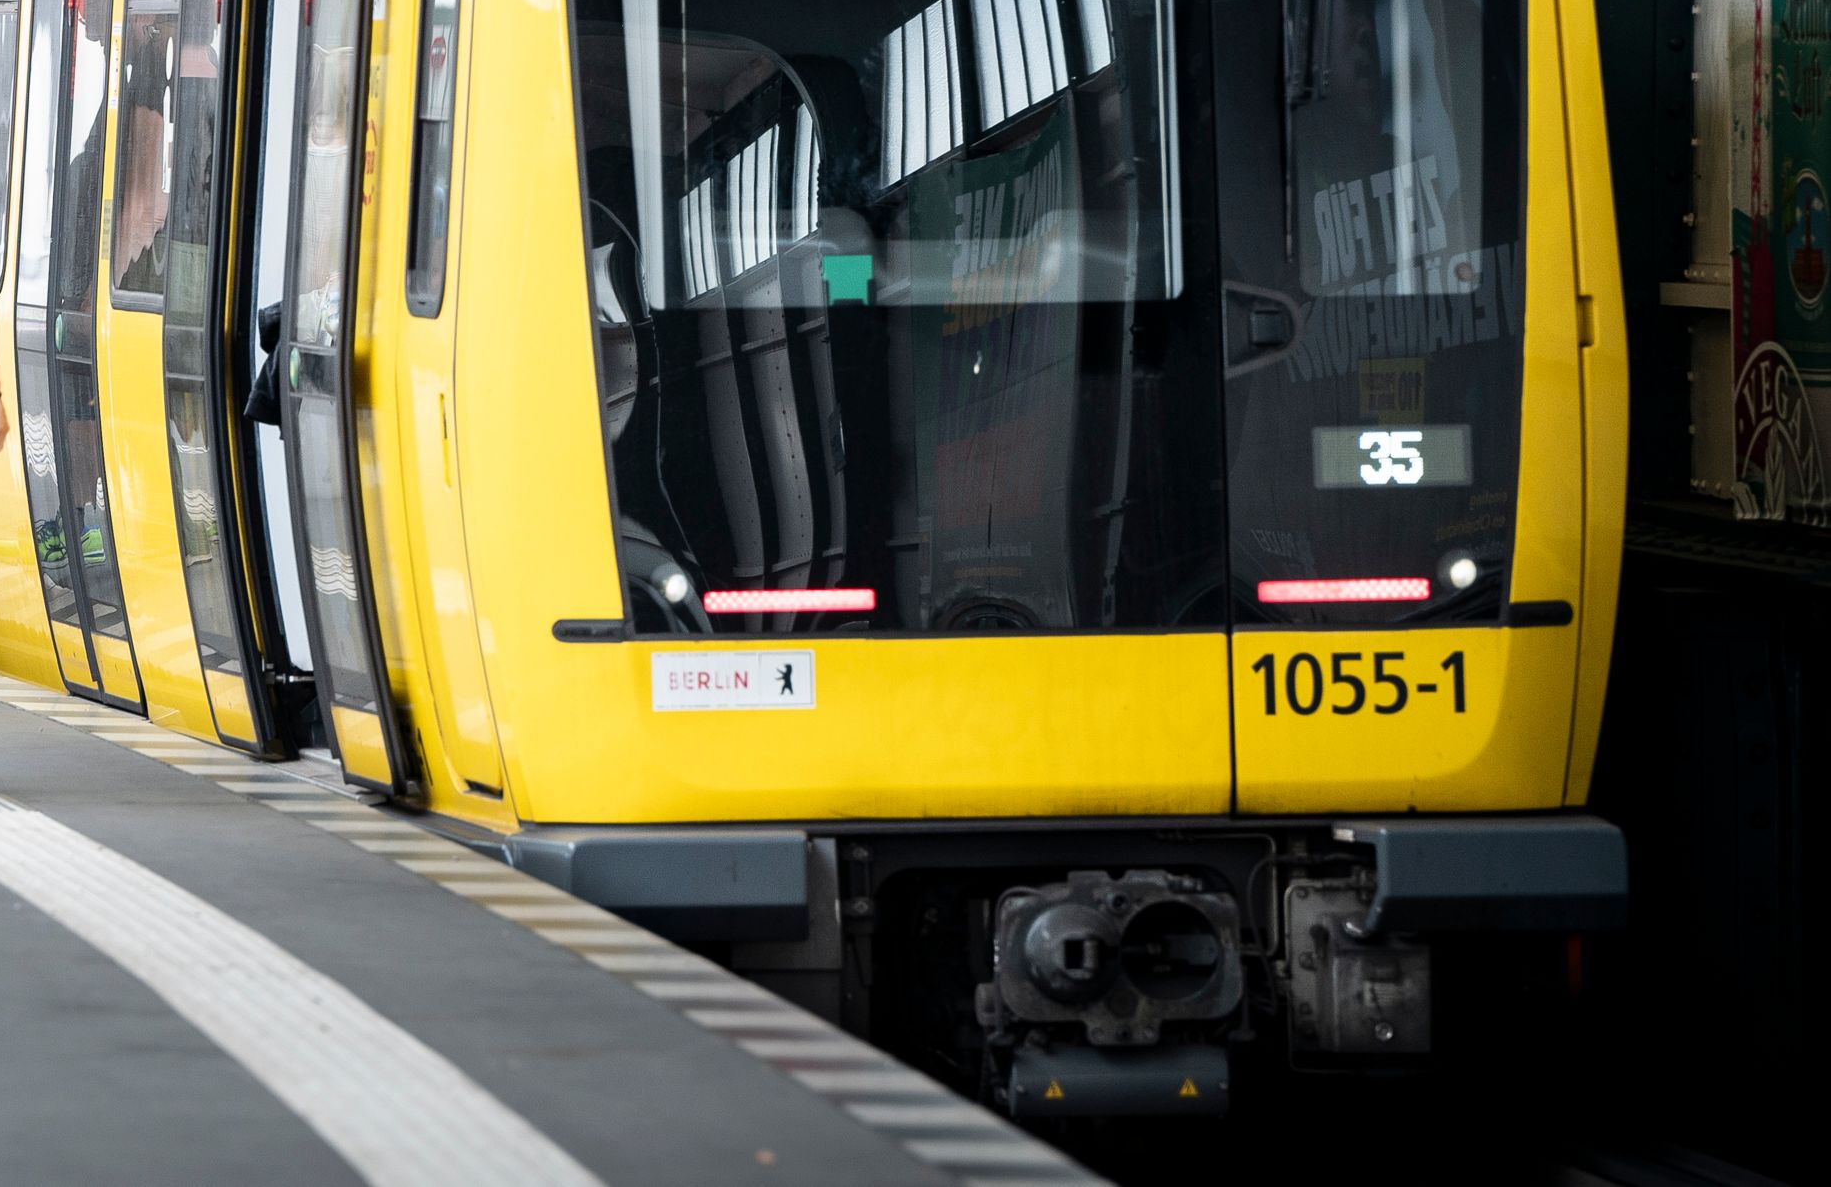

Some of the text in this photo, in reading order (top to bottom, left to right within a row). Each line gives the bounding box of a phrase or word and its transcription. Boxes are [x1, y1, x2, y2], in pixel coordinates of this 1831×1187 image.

[1360, 431, 1424, 484] 35
[1743, 360, 1820, 505] VEGAN
[668, 671, 749, 691] BERLIN
[1251, 650, 1467, 716] 1055-1
